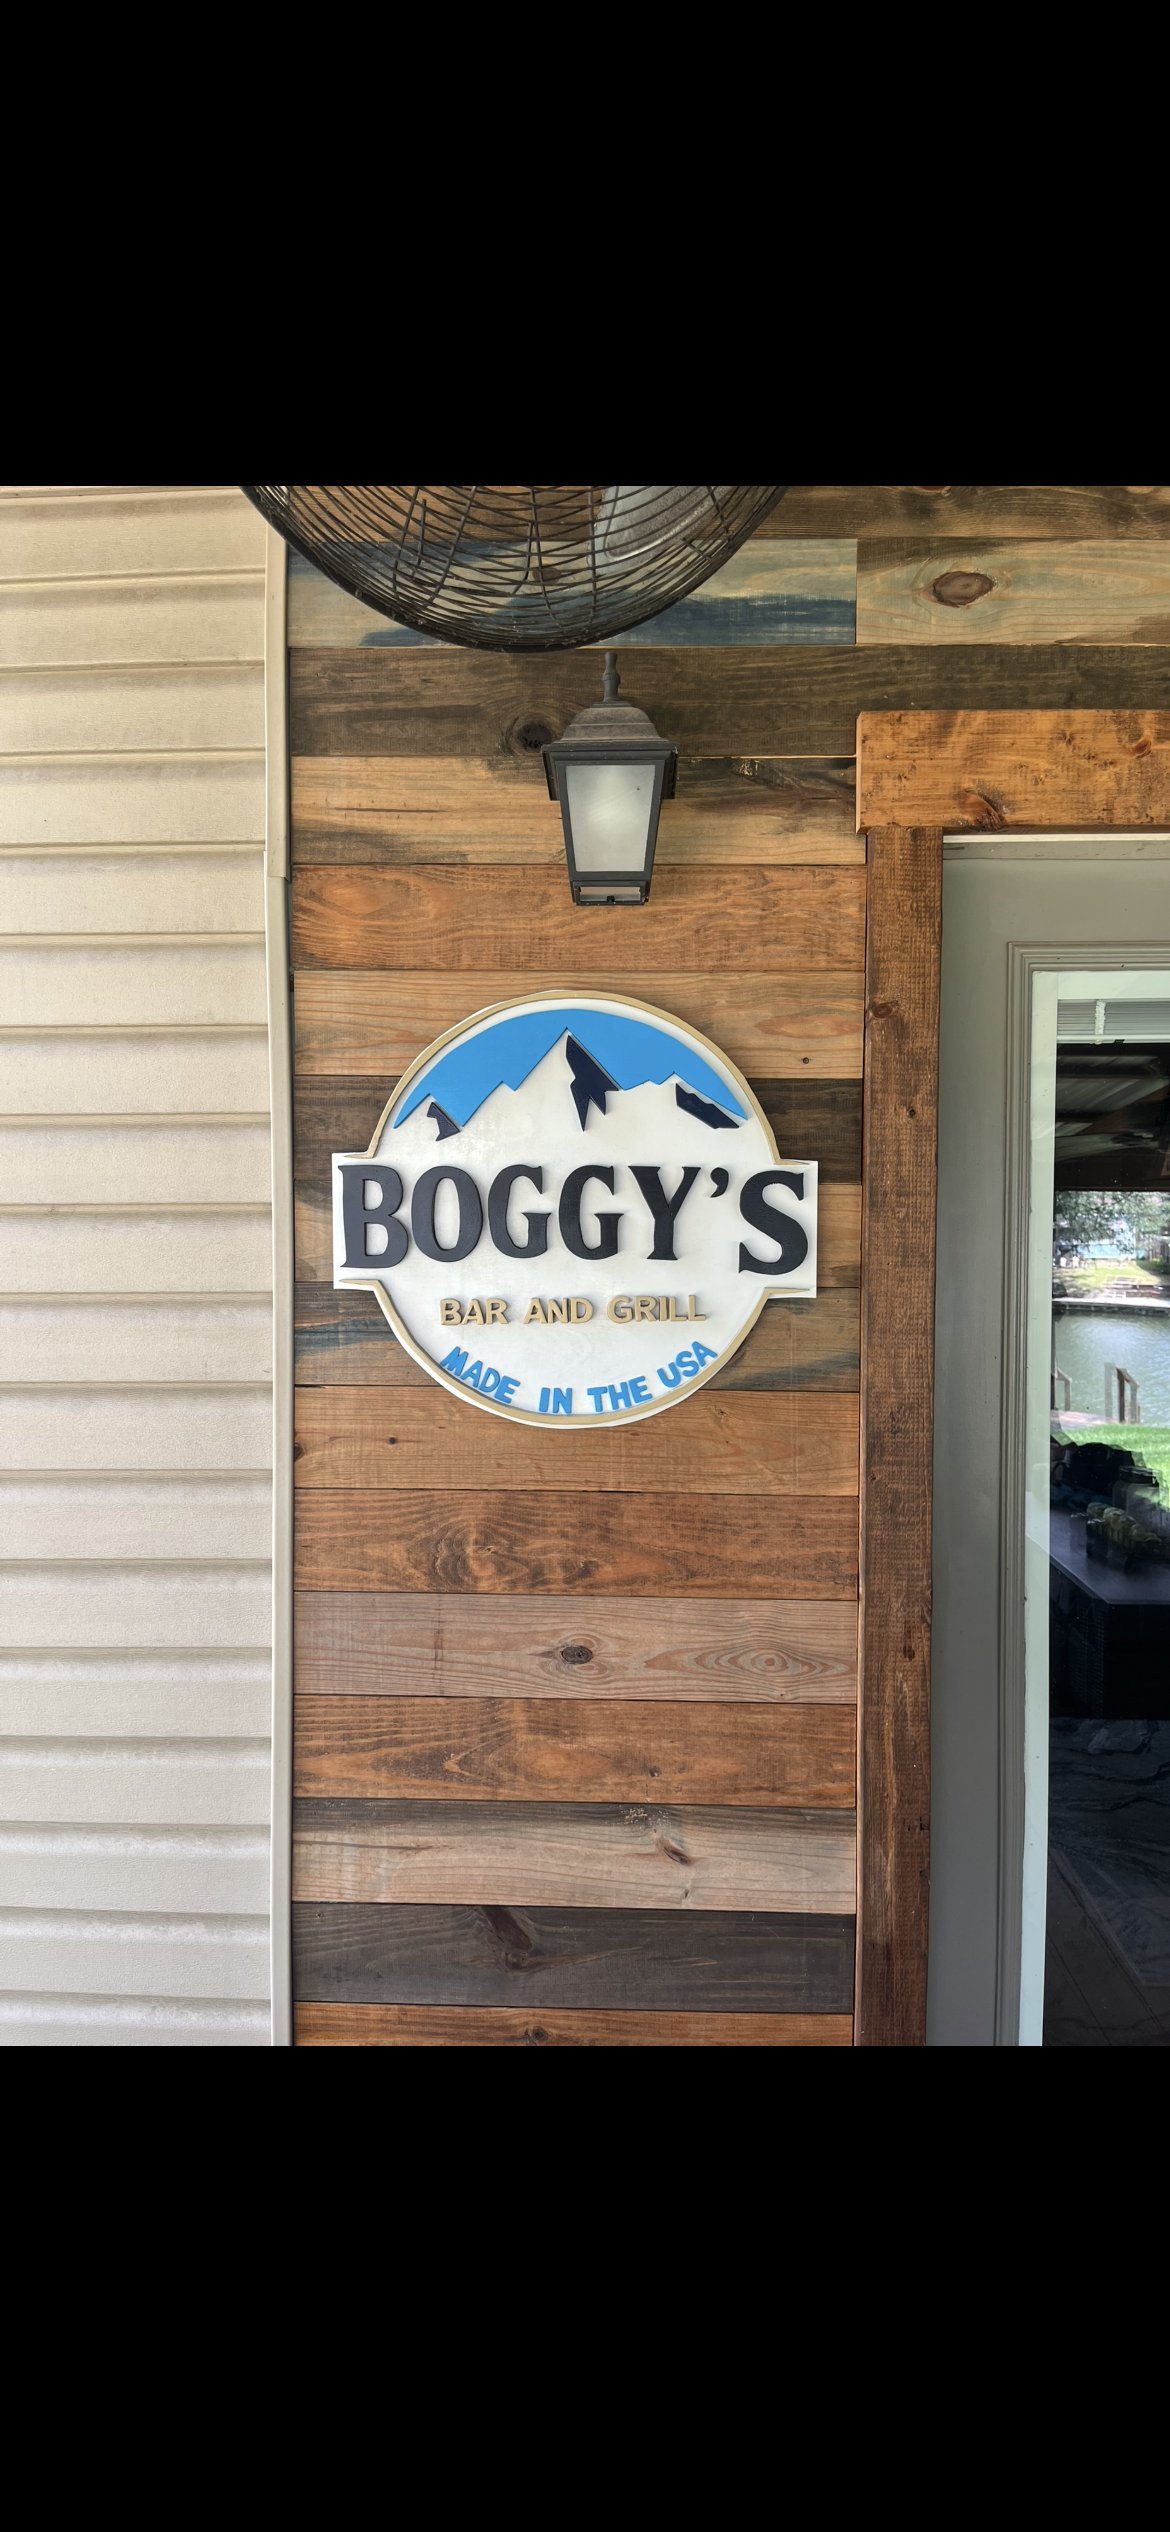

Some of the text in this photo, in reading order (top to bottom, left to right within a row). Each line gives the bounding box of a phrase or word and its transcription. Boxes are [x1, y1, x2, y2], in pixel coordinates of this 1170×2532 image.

[338, 1165, 809, 1275] BOGGY'S
[440, 1295, 706, 1326] BAR AND GRILL
[440, 1341, 717, 1414] MADE IN THE USA
